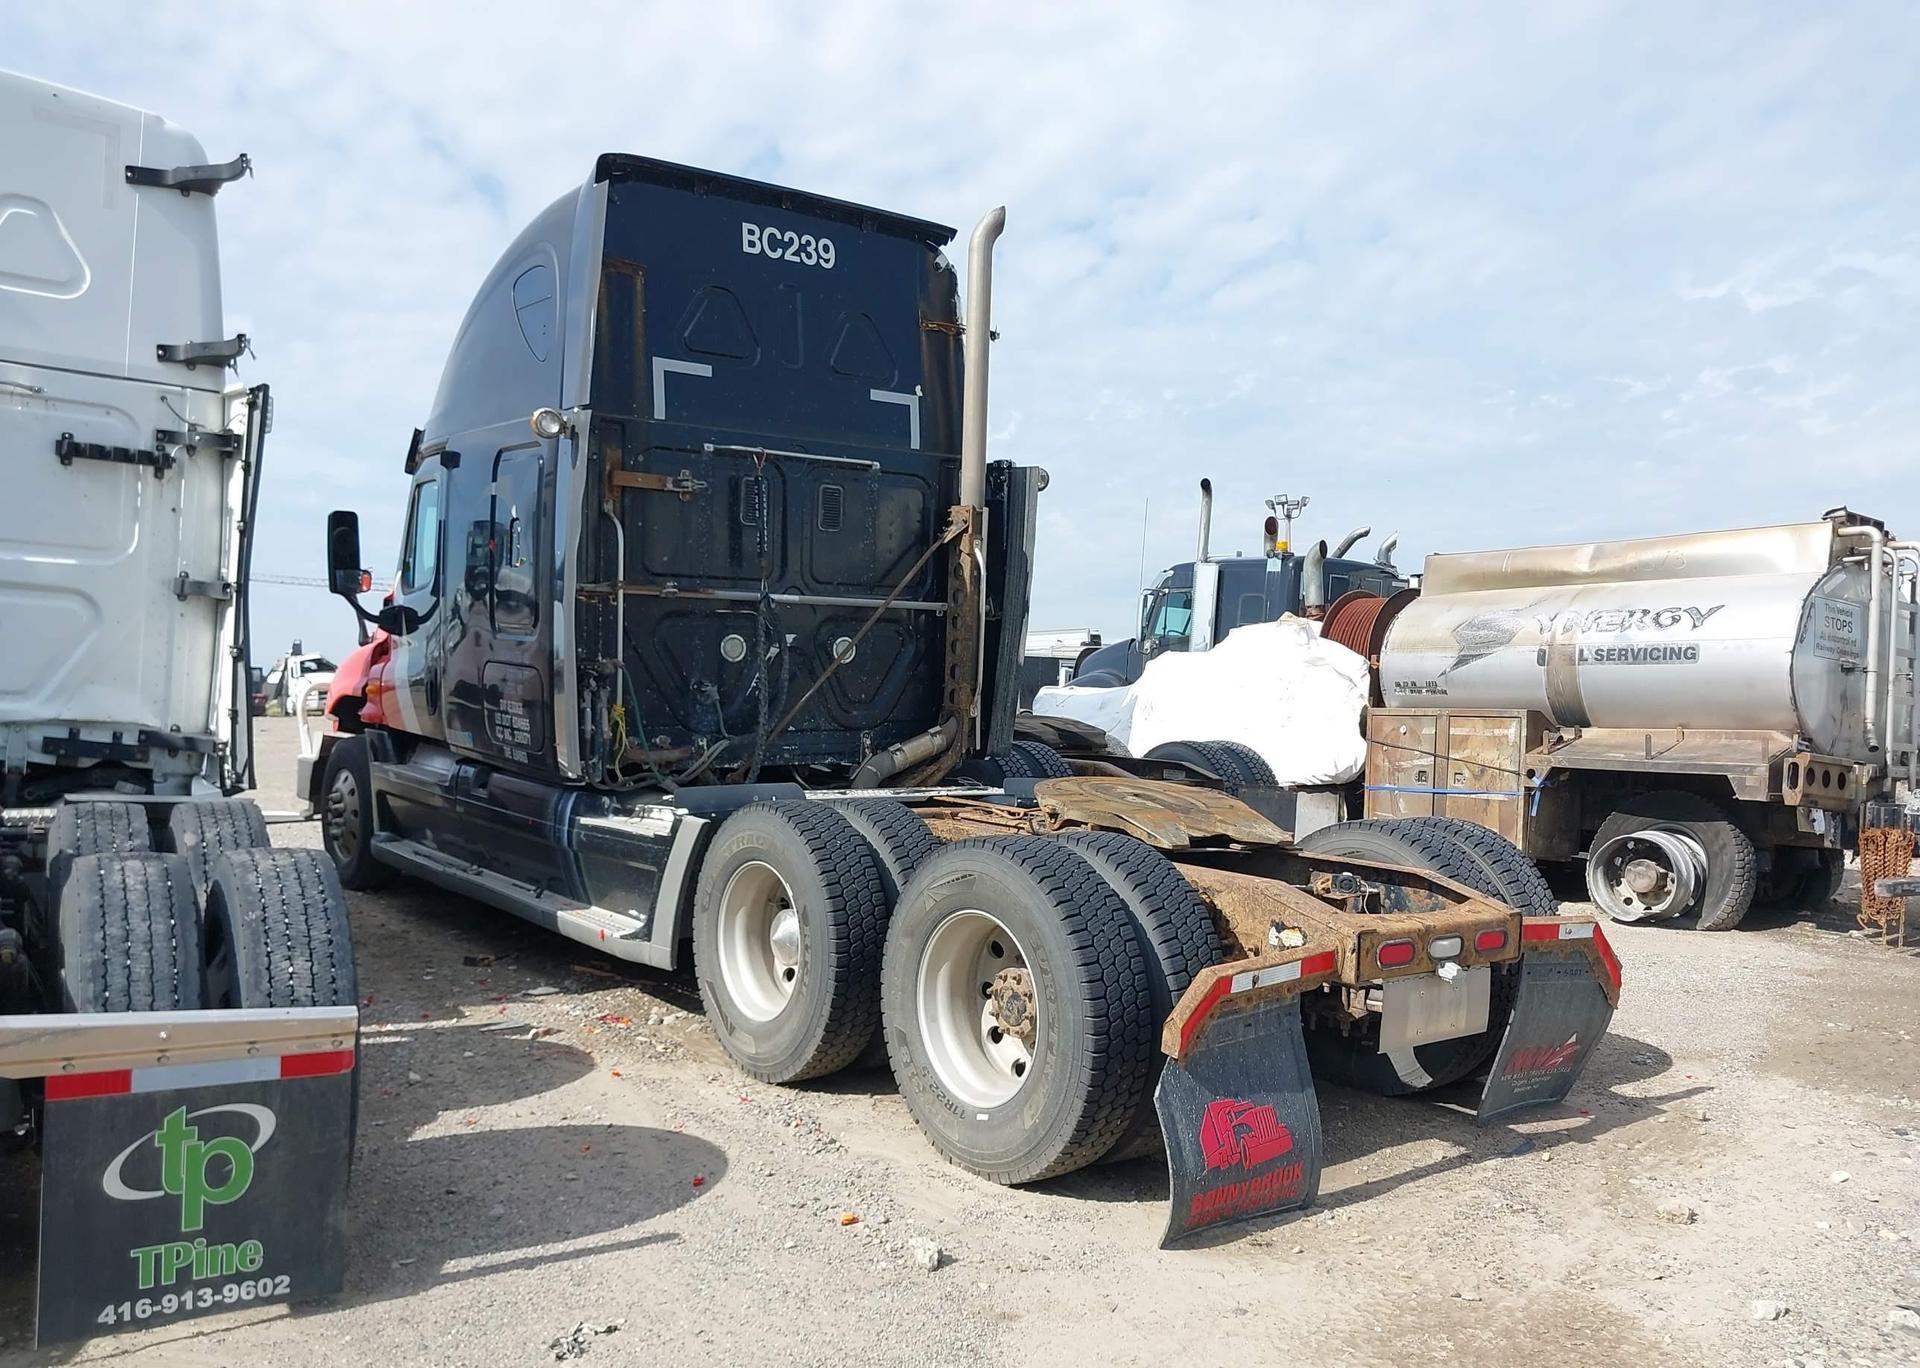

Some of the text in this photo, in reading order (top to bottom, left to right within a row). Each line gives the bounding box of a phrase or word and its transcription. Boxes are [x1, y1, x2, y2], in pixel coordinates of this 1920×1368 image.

[742, 222, 836, 269] BC239
[1824, 616, 1853, 633] STOPS
[1594, 646, 1697, 662] SERVICING
[130, 1238, 264, 1290] TPine
[97, 1275, 291, 1326] 416-913-9602
